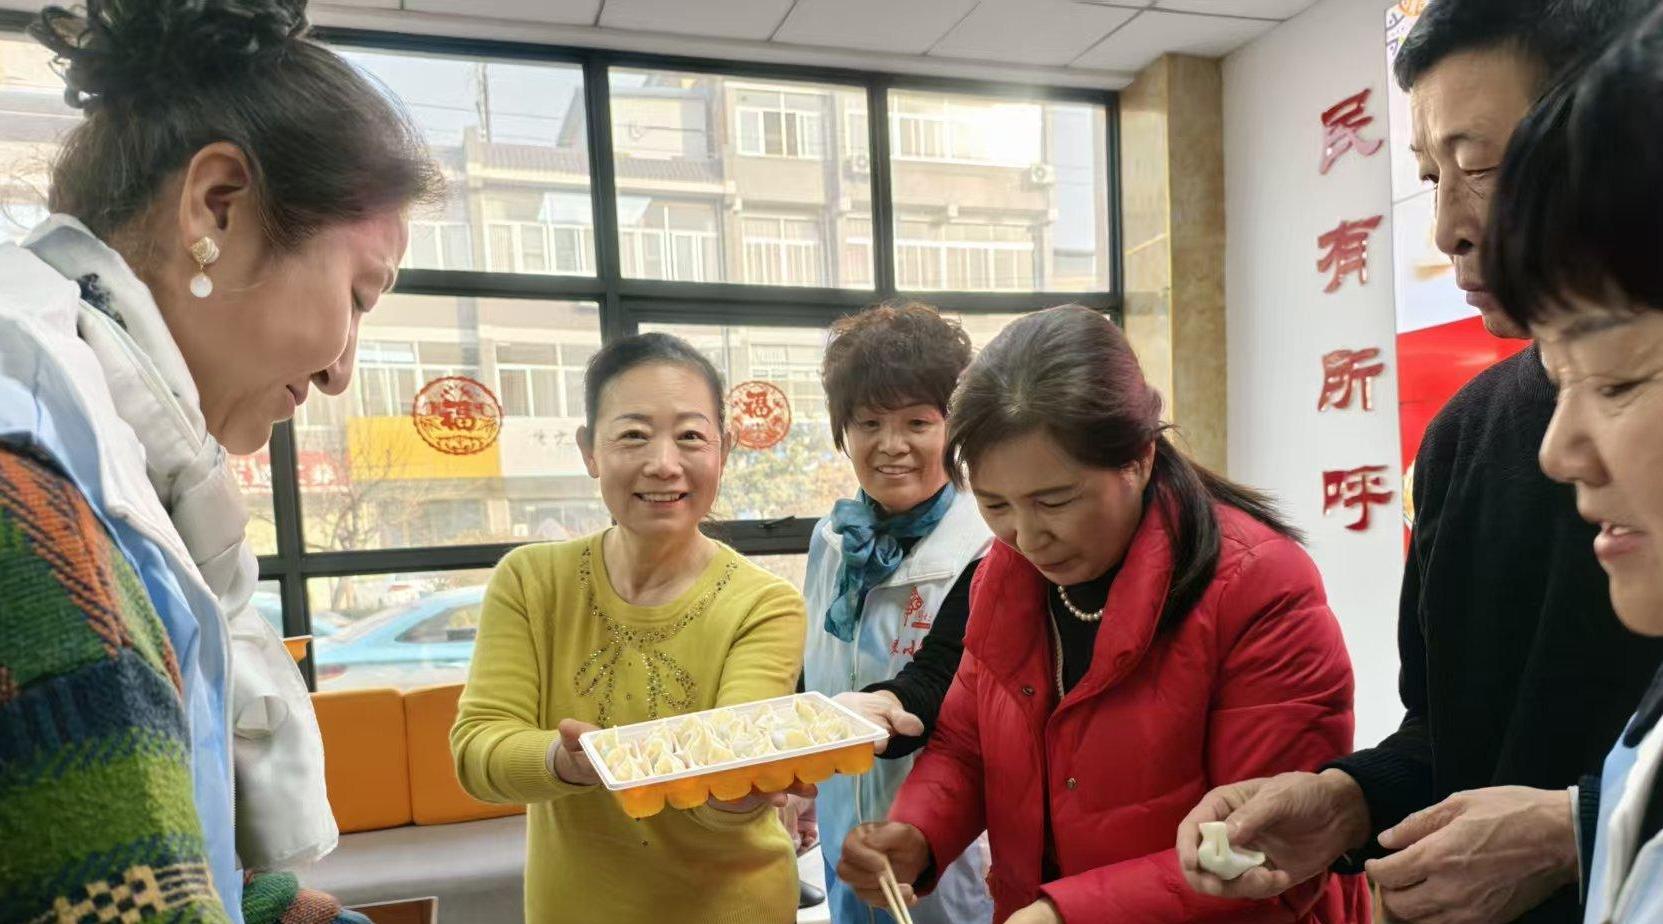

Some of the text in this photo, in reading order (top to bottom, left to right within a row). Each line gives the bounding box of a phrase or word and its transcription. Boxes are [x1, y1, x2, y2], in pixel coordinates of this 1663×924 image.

[1317, 88, 1394, 532] 民有所呼
[441, 399, 476, 430] 福
[743, 391, 772, 418] 福
